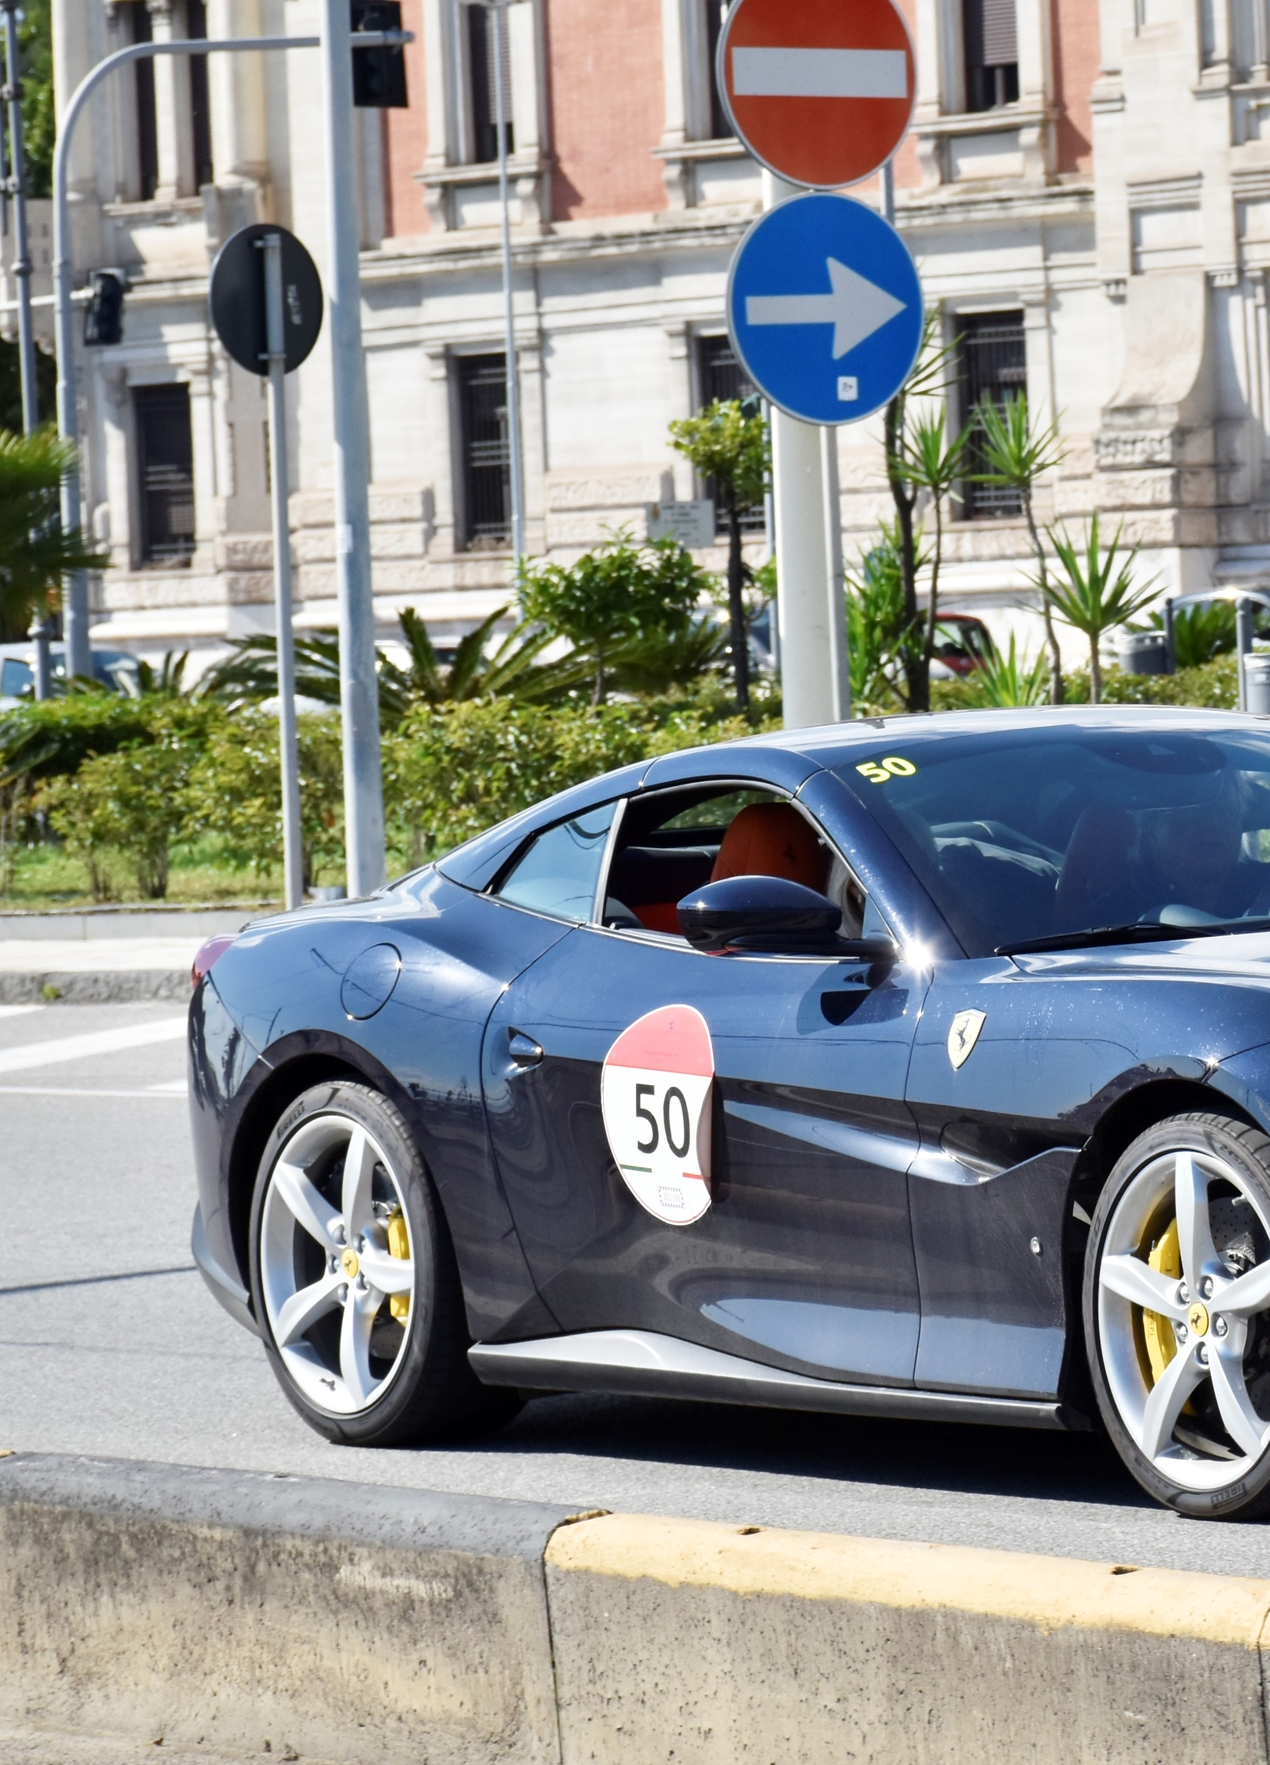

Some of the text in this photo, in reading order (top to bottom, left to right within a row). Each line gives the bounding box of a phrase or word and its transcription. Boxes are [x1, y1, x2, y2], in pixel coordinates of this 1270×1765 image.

[855, 757, 916, 784] 50
[635, 1083, 691, 1159] 50
[1210, 1482, 1248, 1509] PIRELLI
